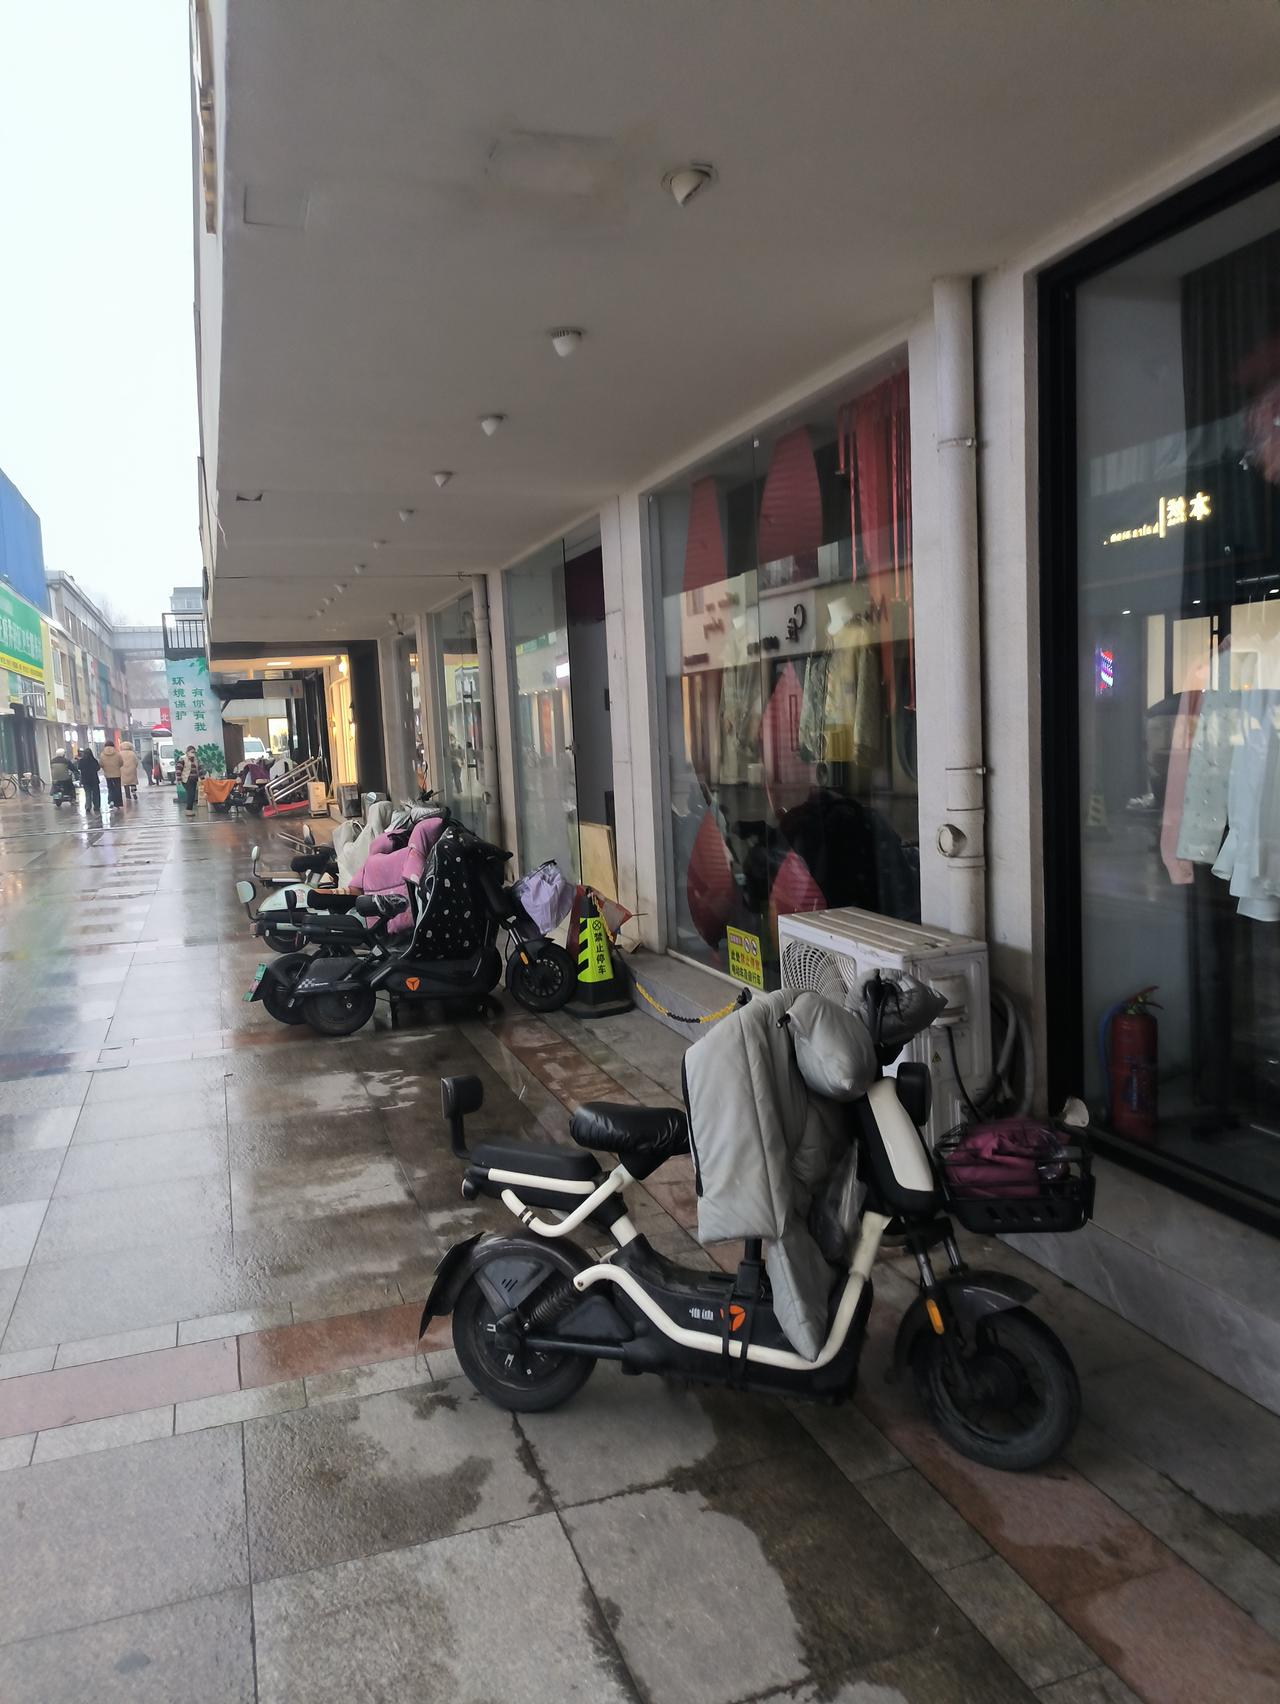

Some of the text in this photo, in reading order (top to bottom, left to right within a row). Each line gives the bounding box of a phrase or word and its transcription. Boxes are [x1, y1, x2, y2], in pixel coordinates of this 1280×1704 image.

[172, 676, 187, 720] 环境保护
[192, 687, 207, 731] 有你有我
[593, 932, 606, 974] 禁止停车
